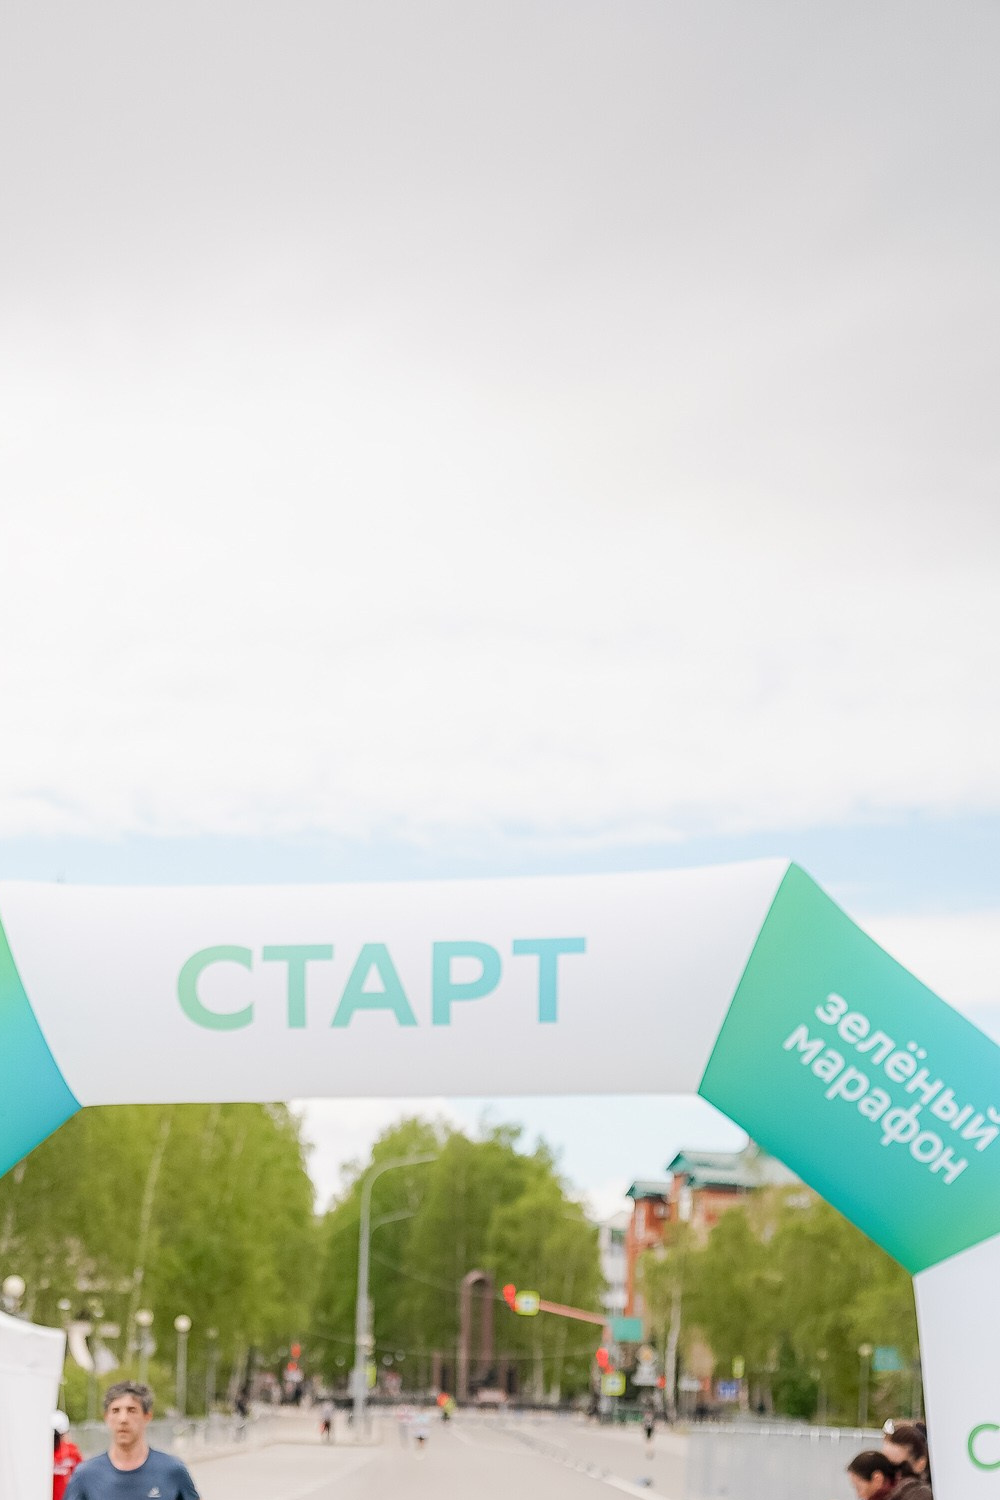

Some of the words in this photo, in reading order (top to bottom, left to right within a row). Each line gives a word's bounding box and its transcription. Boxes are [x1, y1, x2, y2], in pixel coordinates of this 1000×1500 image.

[177, 937, 587, 1032] СТАРТ
[782, 1023, 969, 1186] марафон
[814, 991, 1000, 1153] зелёный
